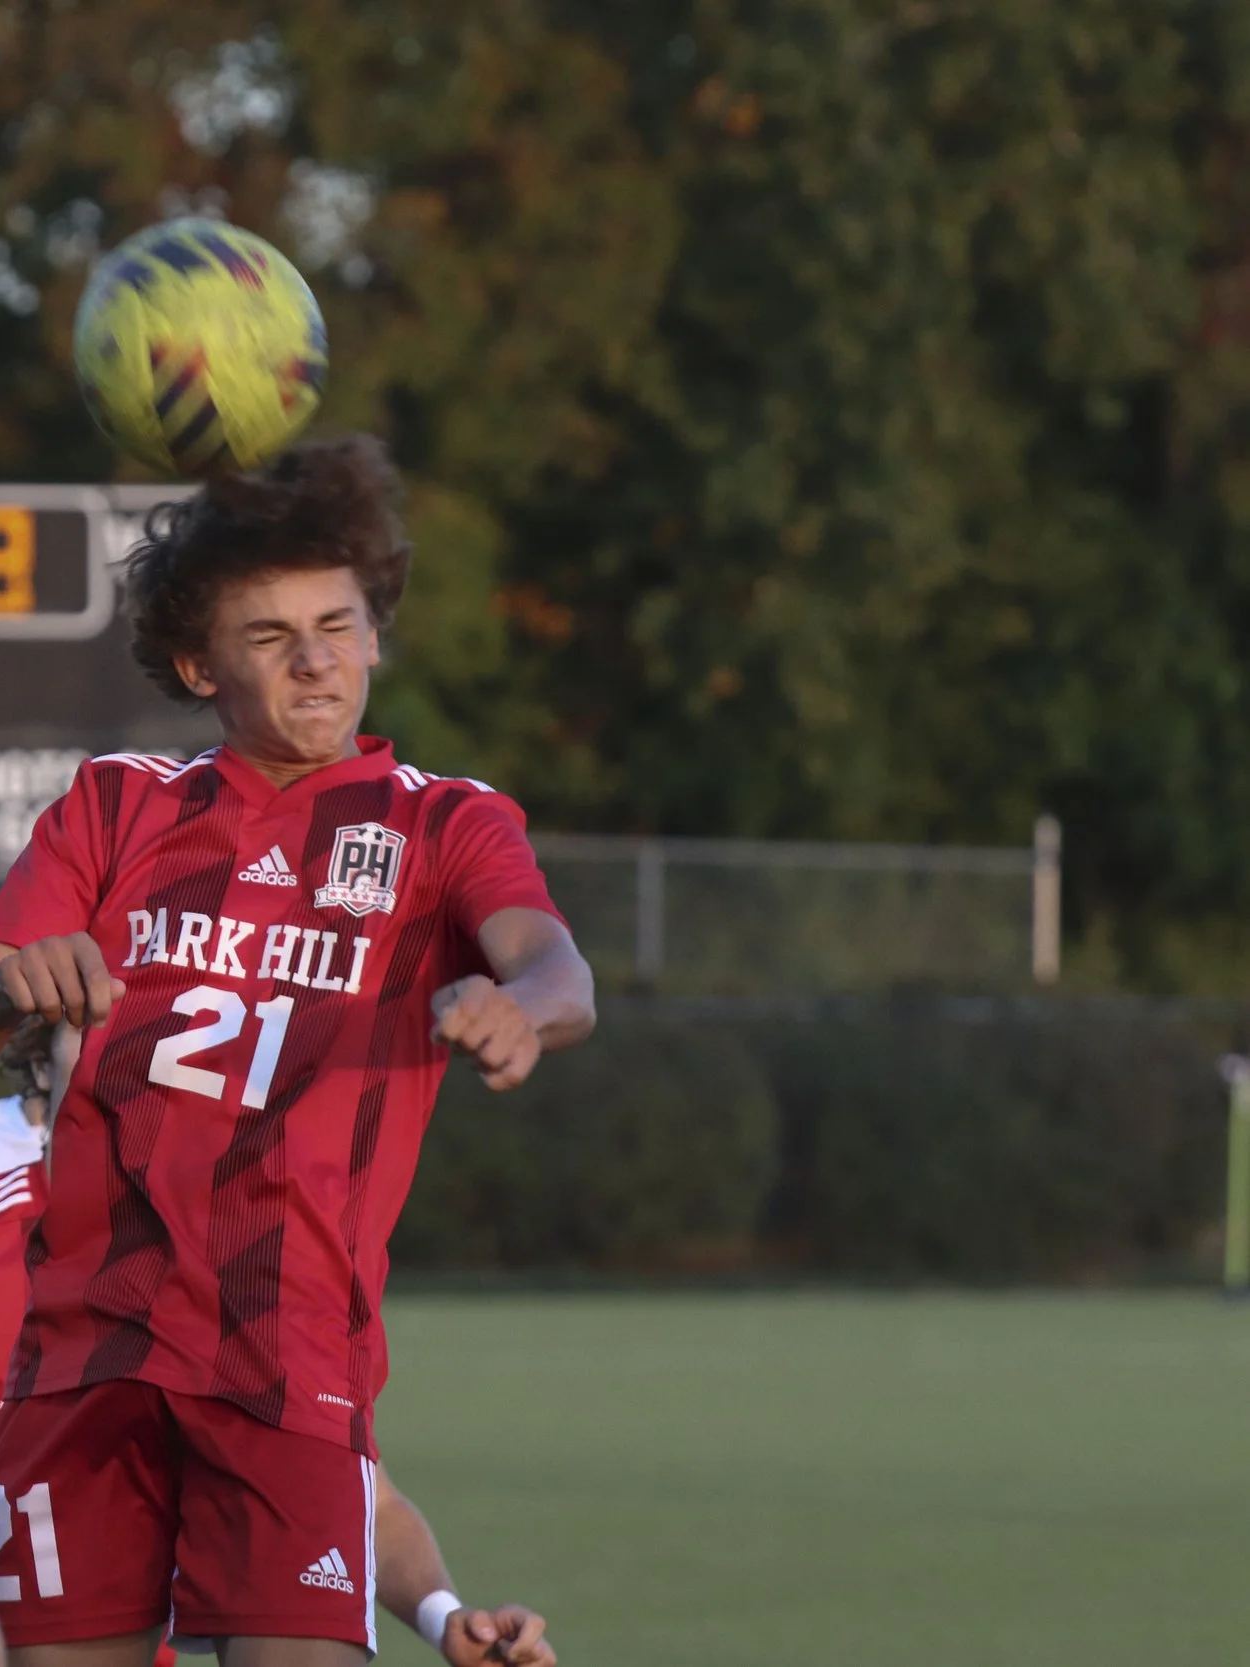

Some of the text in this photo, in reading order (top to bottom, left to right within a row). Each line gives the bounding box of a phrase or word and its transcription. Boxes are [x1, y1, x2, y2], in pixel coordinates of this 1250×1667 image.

[238, 869, 298, 887] adidas
[338, 841, 394, 888] PH
[121, 907, 256, 979] PARK
[148, 984, 295, 1110] 21
[299, 1571, 354, 1594] adidas
